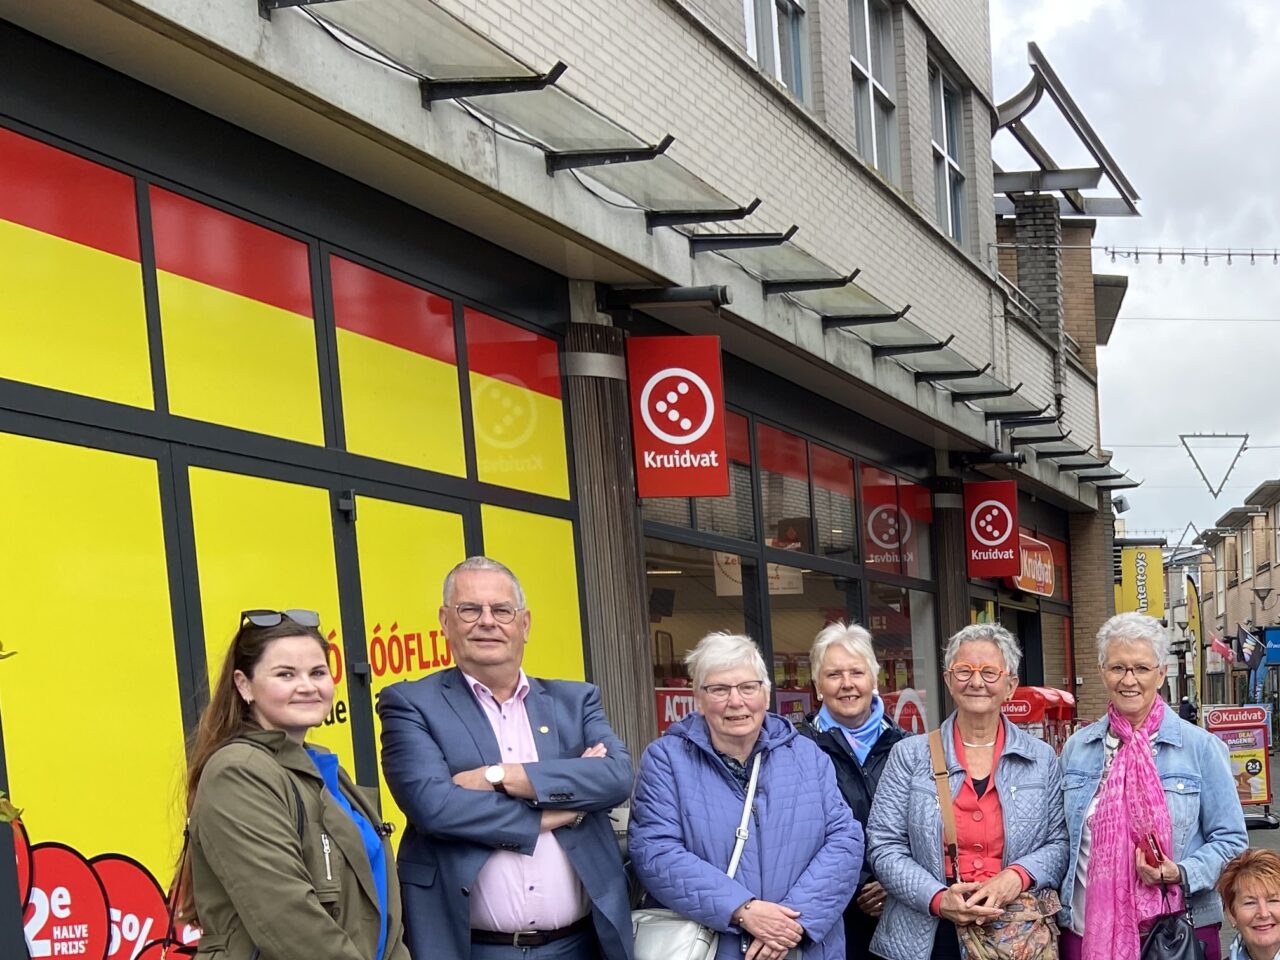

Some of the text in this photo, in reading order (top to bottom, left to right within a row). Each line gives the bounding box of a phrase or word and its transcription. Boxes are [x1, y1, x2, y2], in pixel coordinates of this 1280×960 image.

[644, 449, 719, 468] Kruidvat
[971, 549, 1014, 560] Kruidvat
[1222, 711, 1262, 721] Kruidvat
[53, 924, 89, 940] HALVE
